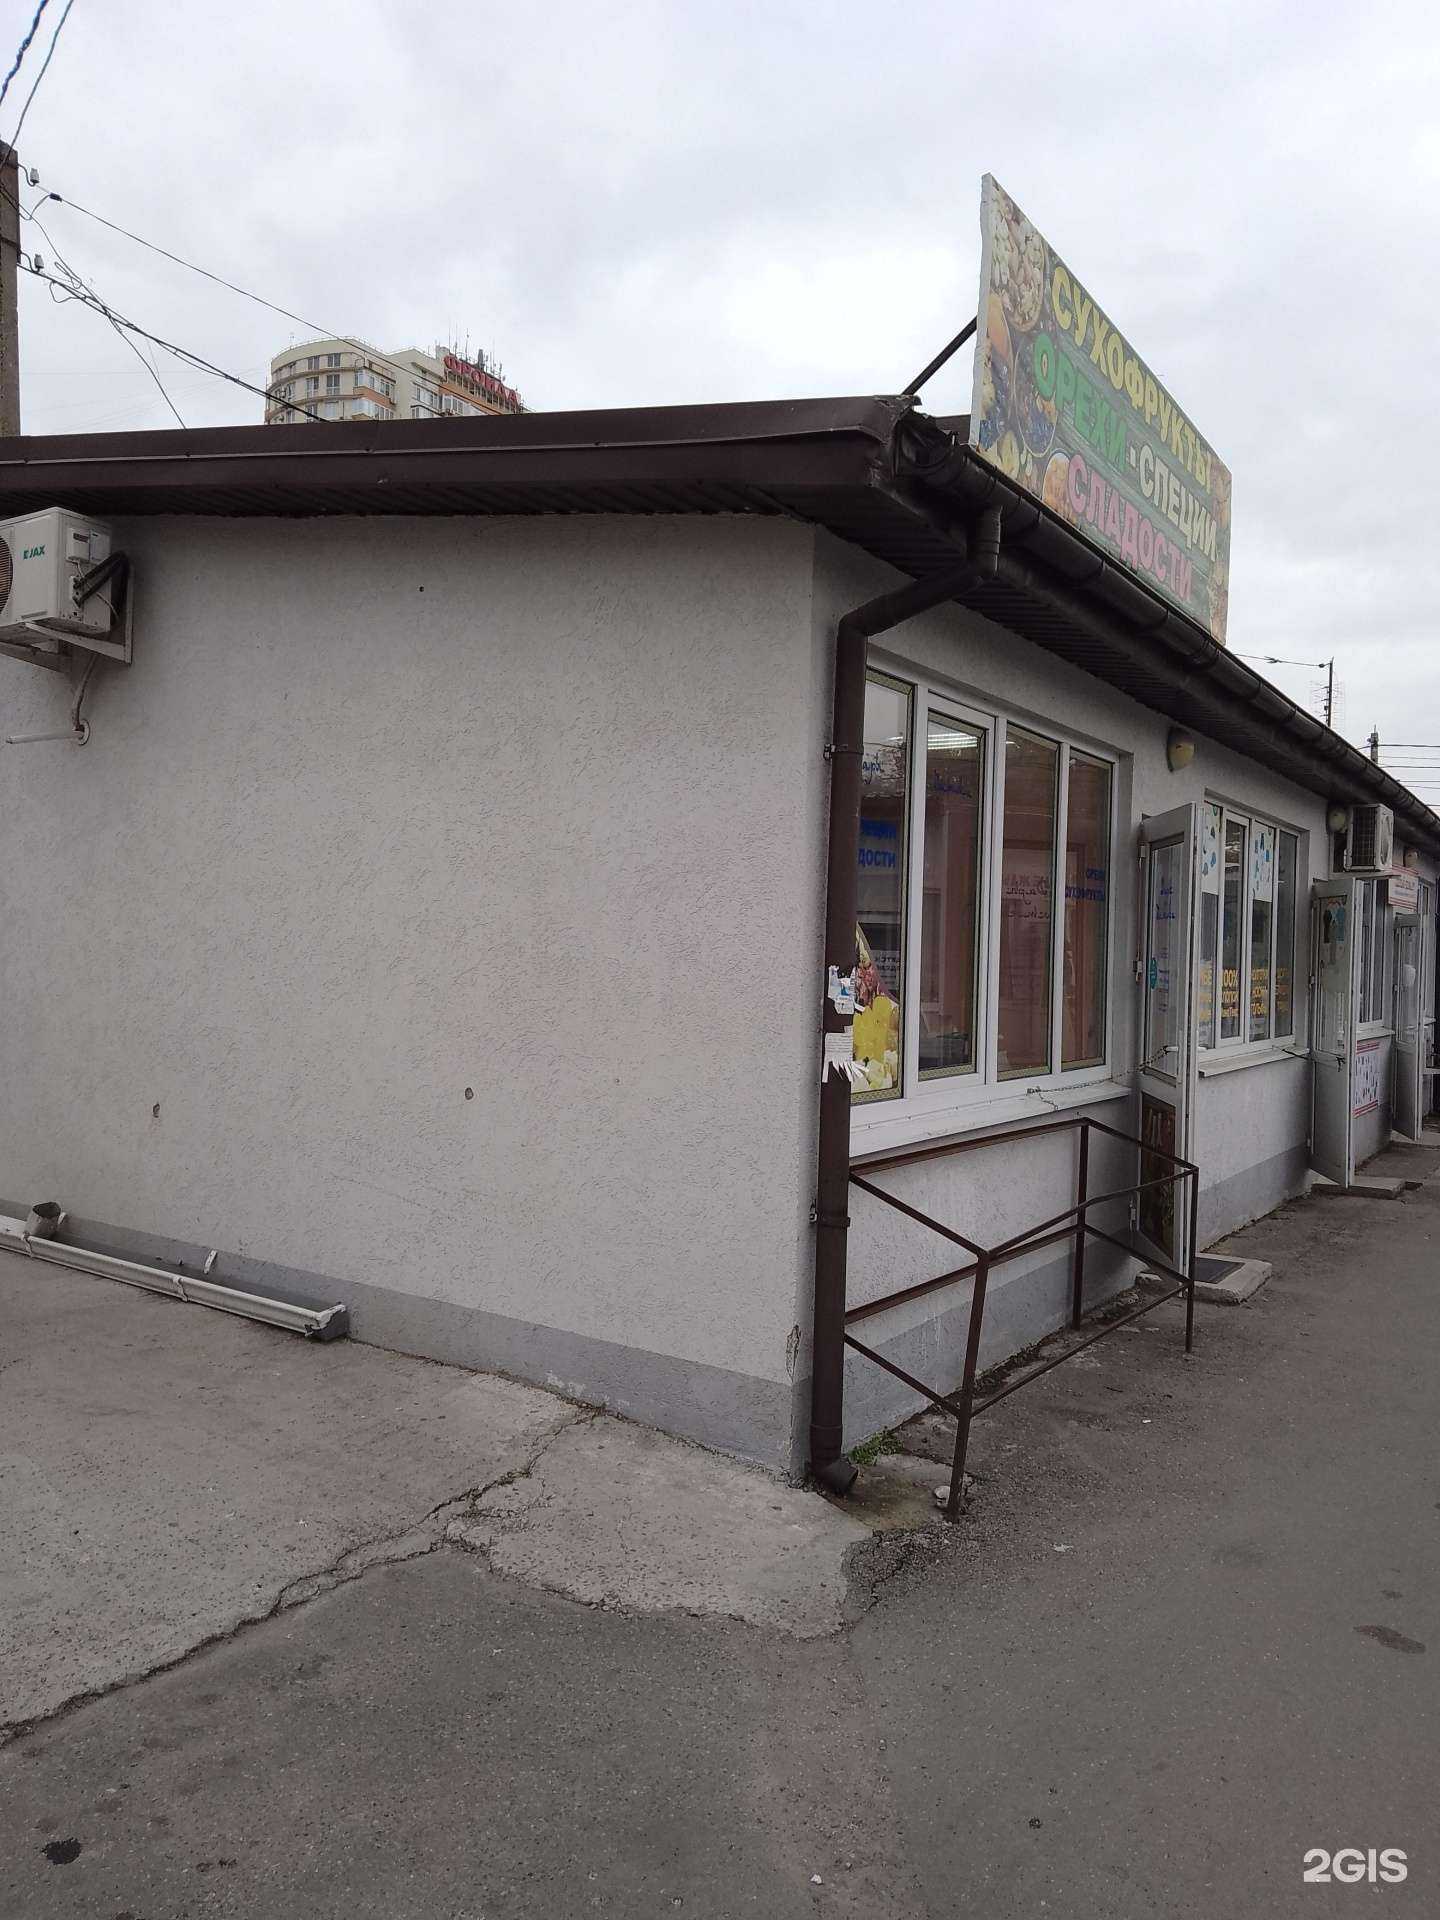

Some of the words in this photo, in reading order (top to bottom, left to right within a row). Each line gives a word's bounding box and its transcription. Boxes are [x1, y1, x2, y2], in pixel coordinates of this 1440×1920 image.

[1033, 333, 1129, 473] ОРЕХИ
[1139, 443, 1218, 562] СПЕЦИИ
[1051, 265, 1211, 496] СУХОФРУКТЫ
[1067, 454, 1193, 602] СЛАДОСТИ
[858, 848, 896, 868] ДОСТИ
